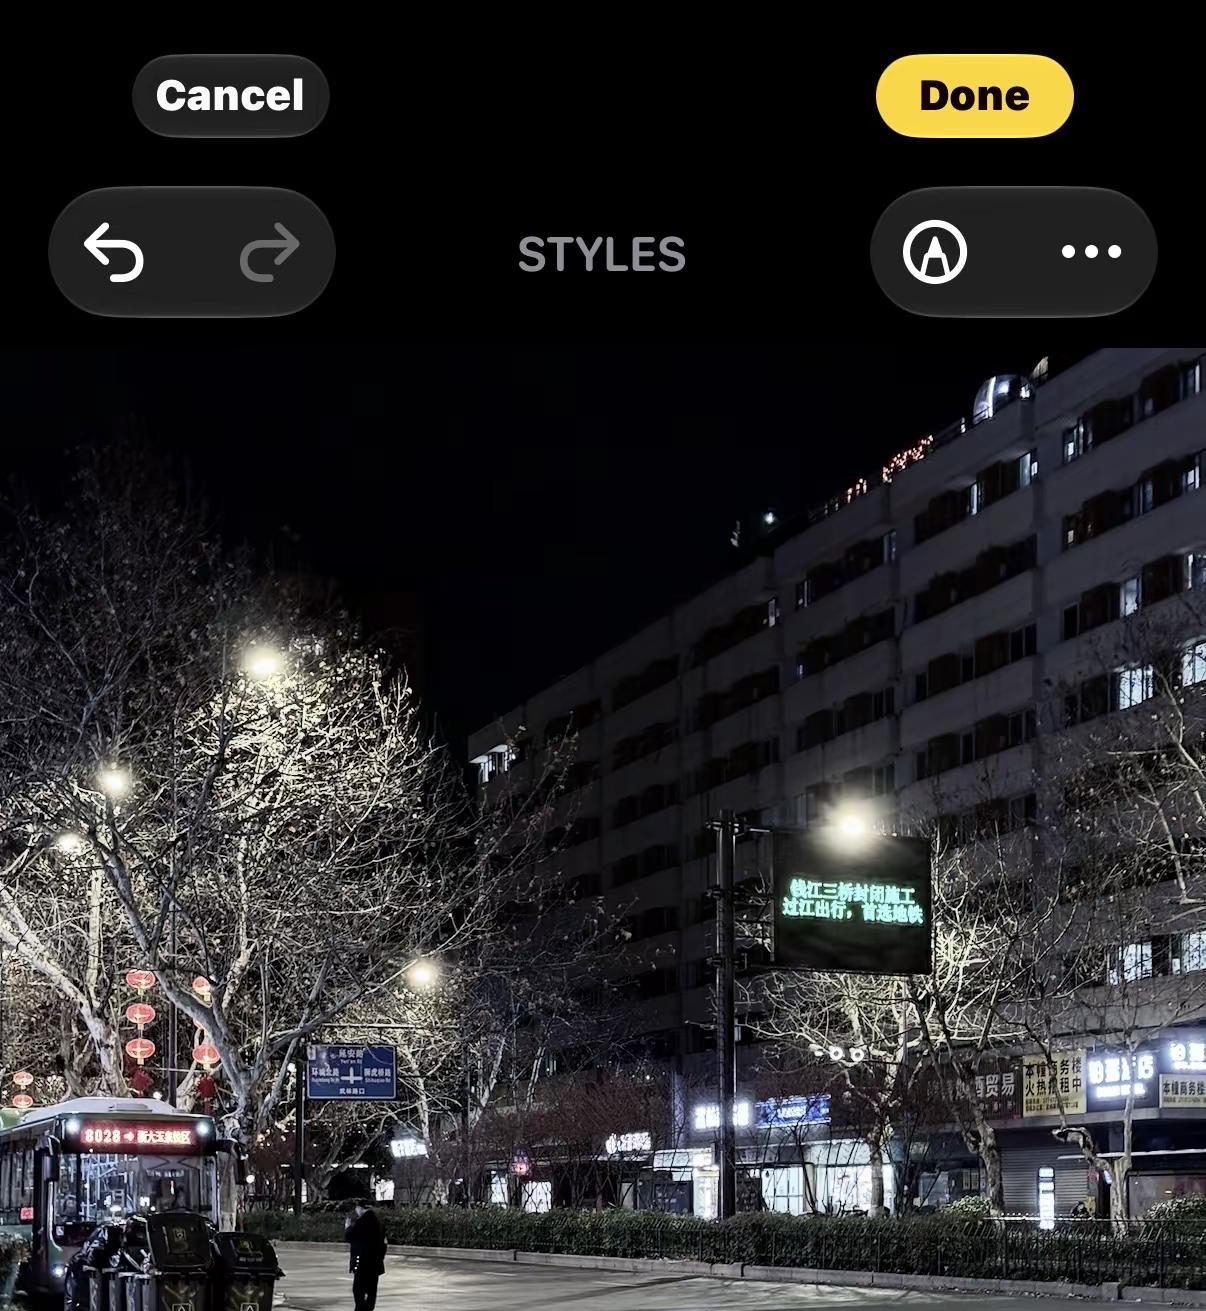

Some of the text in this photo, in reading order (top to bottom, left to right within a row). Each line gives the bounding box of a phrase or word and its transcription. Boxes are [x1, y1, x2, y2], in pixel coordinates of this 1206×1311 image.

[789, 878, 916, 904] 钱江三桥封闭施工
[85, 1128, 120, 1143] 8028
